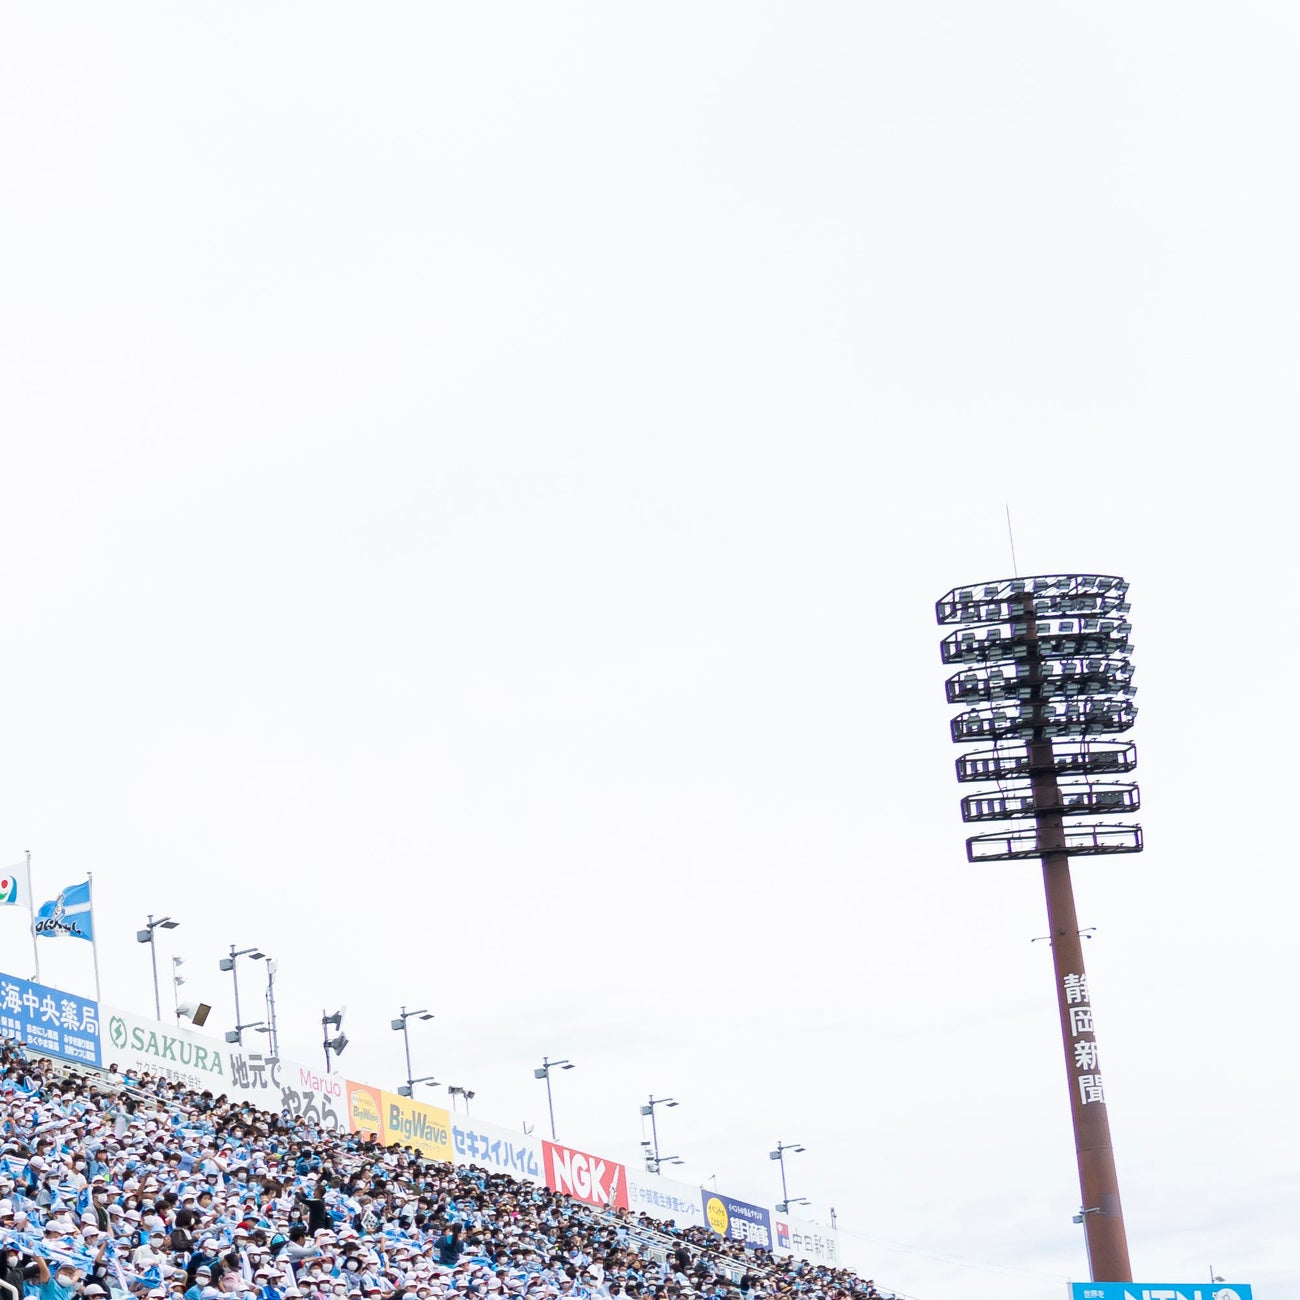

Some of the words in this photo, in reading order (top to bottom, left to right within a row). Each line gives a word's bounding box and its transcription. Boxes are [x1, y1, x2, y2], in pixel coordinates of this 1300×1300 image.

[131, 1027, 224, 1075] SAKURA
[1064, 973, 1106, 1105] 静岡新聞
[230, 1053, 280, 1089] 地元で
[300, 1068, 342, 1097] Maruo
[389, 1103, 448, 1146] BigWave
[453, 1126, 539, 1176] セキスイハイム
[552, 1145, 610, 1202] NGK
